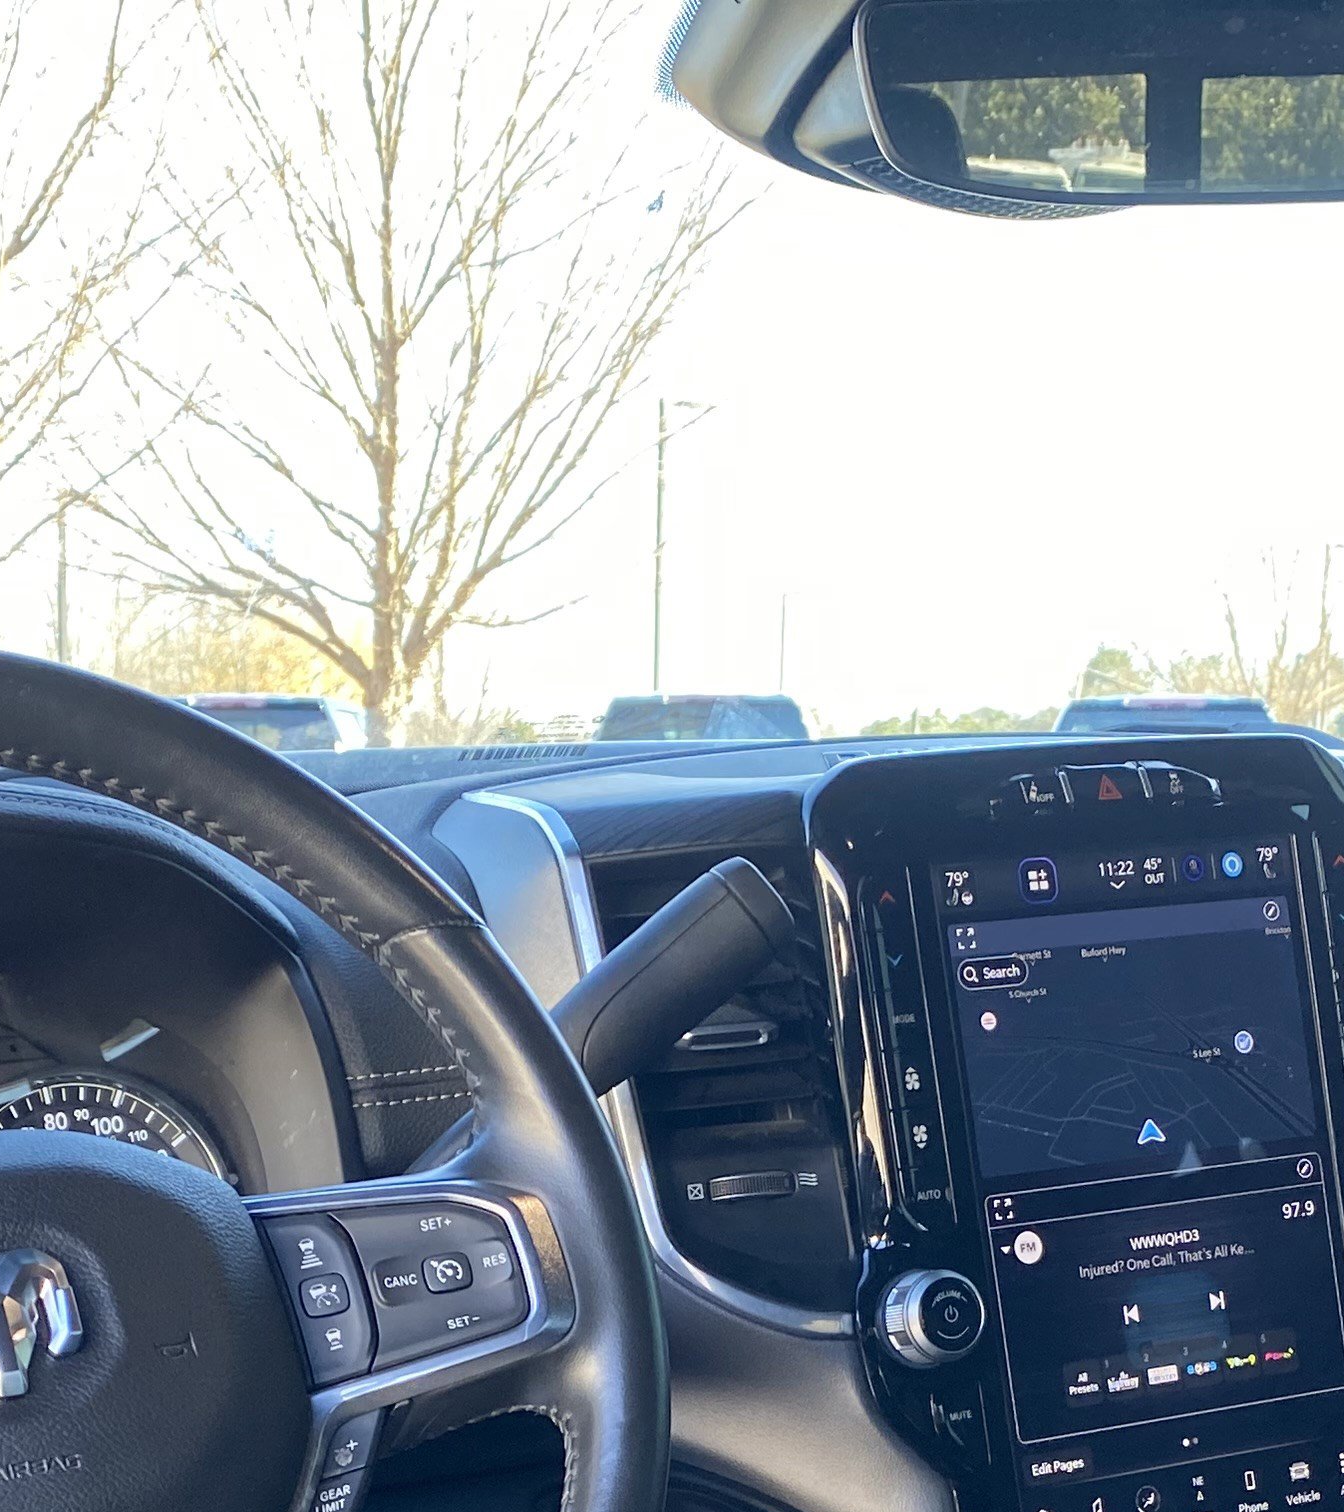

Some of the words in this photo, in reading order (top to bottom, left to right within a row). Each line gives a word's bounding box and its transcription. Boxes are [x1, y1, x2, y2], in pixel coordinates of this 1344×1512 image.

[1098, 860, 1135, 877] 11:22
[1144, 872, 1165, 885] OUT
[1080, 947, 1106, 959] Buford
[1106, 946, 1126, 957] Hwy
[982, 963, 1021, 980] Search
[1014, 988, 1039, 999] Church
[42, 1111, 68, 1131] 80
[73, 1108, 90, 1121] 90
[90, 1115, 124, 1137] 100
[127, 1129, 149, 1143] 110
[917, 1188, 942, 1201] AUTO
[1281, 1200, 1315, 1219] 97.9
[1129, 1228, 1200, 1251] WWWQHD3
[1019, 1241, 1036, 1254] FM
[482, 1252, 507, 1268] RES
[1078, 1258, 1125, 1280] Injured?
[1126, 1257, 1150, 1272] One
[1151, 1253, 1177, 1268] Call,
[1177, 1248, 1213, 1264] That's
[1213, 1245, 1229, 1260] All
[383, 1273, 418, 1289] CANC
[934, 1290, 961, 1302] VOLUME
[1077, 1371, 1089, 1383] All
[1068, 1382, 1100, 1396] Presets
[949, 1409, 973, 1421] MUTE
[1031, 1462, 1053, 1477] Edit
[1053, 1458, 1085, 1475] Pages
[1192, 1476, 1205, 1487] NE
[319, 1484, 351, 1502] GEAR
[1285, 1490, 1321, 1507] Vehicle
